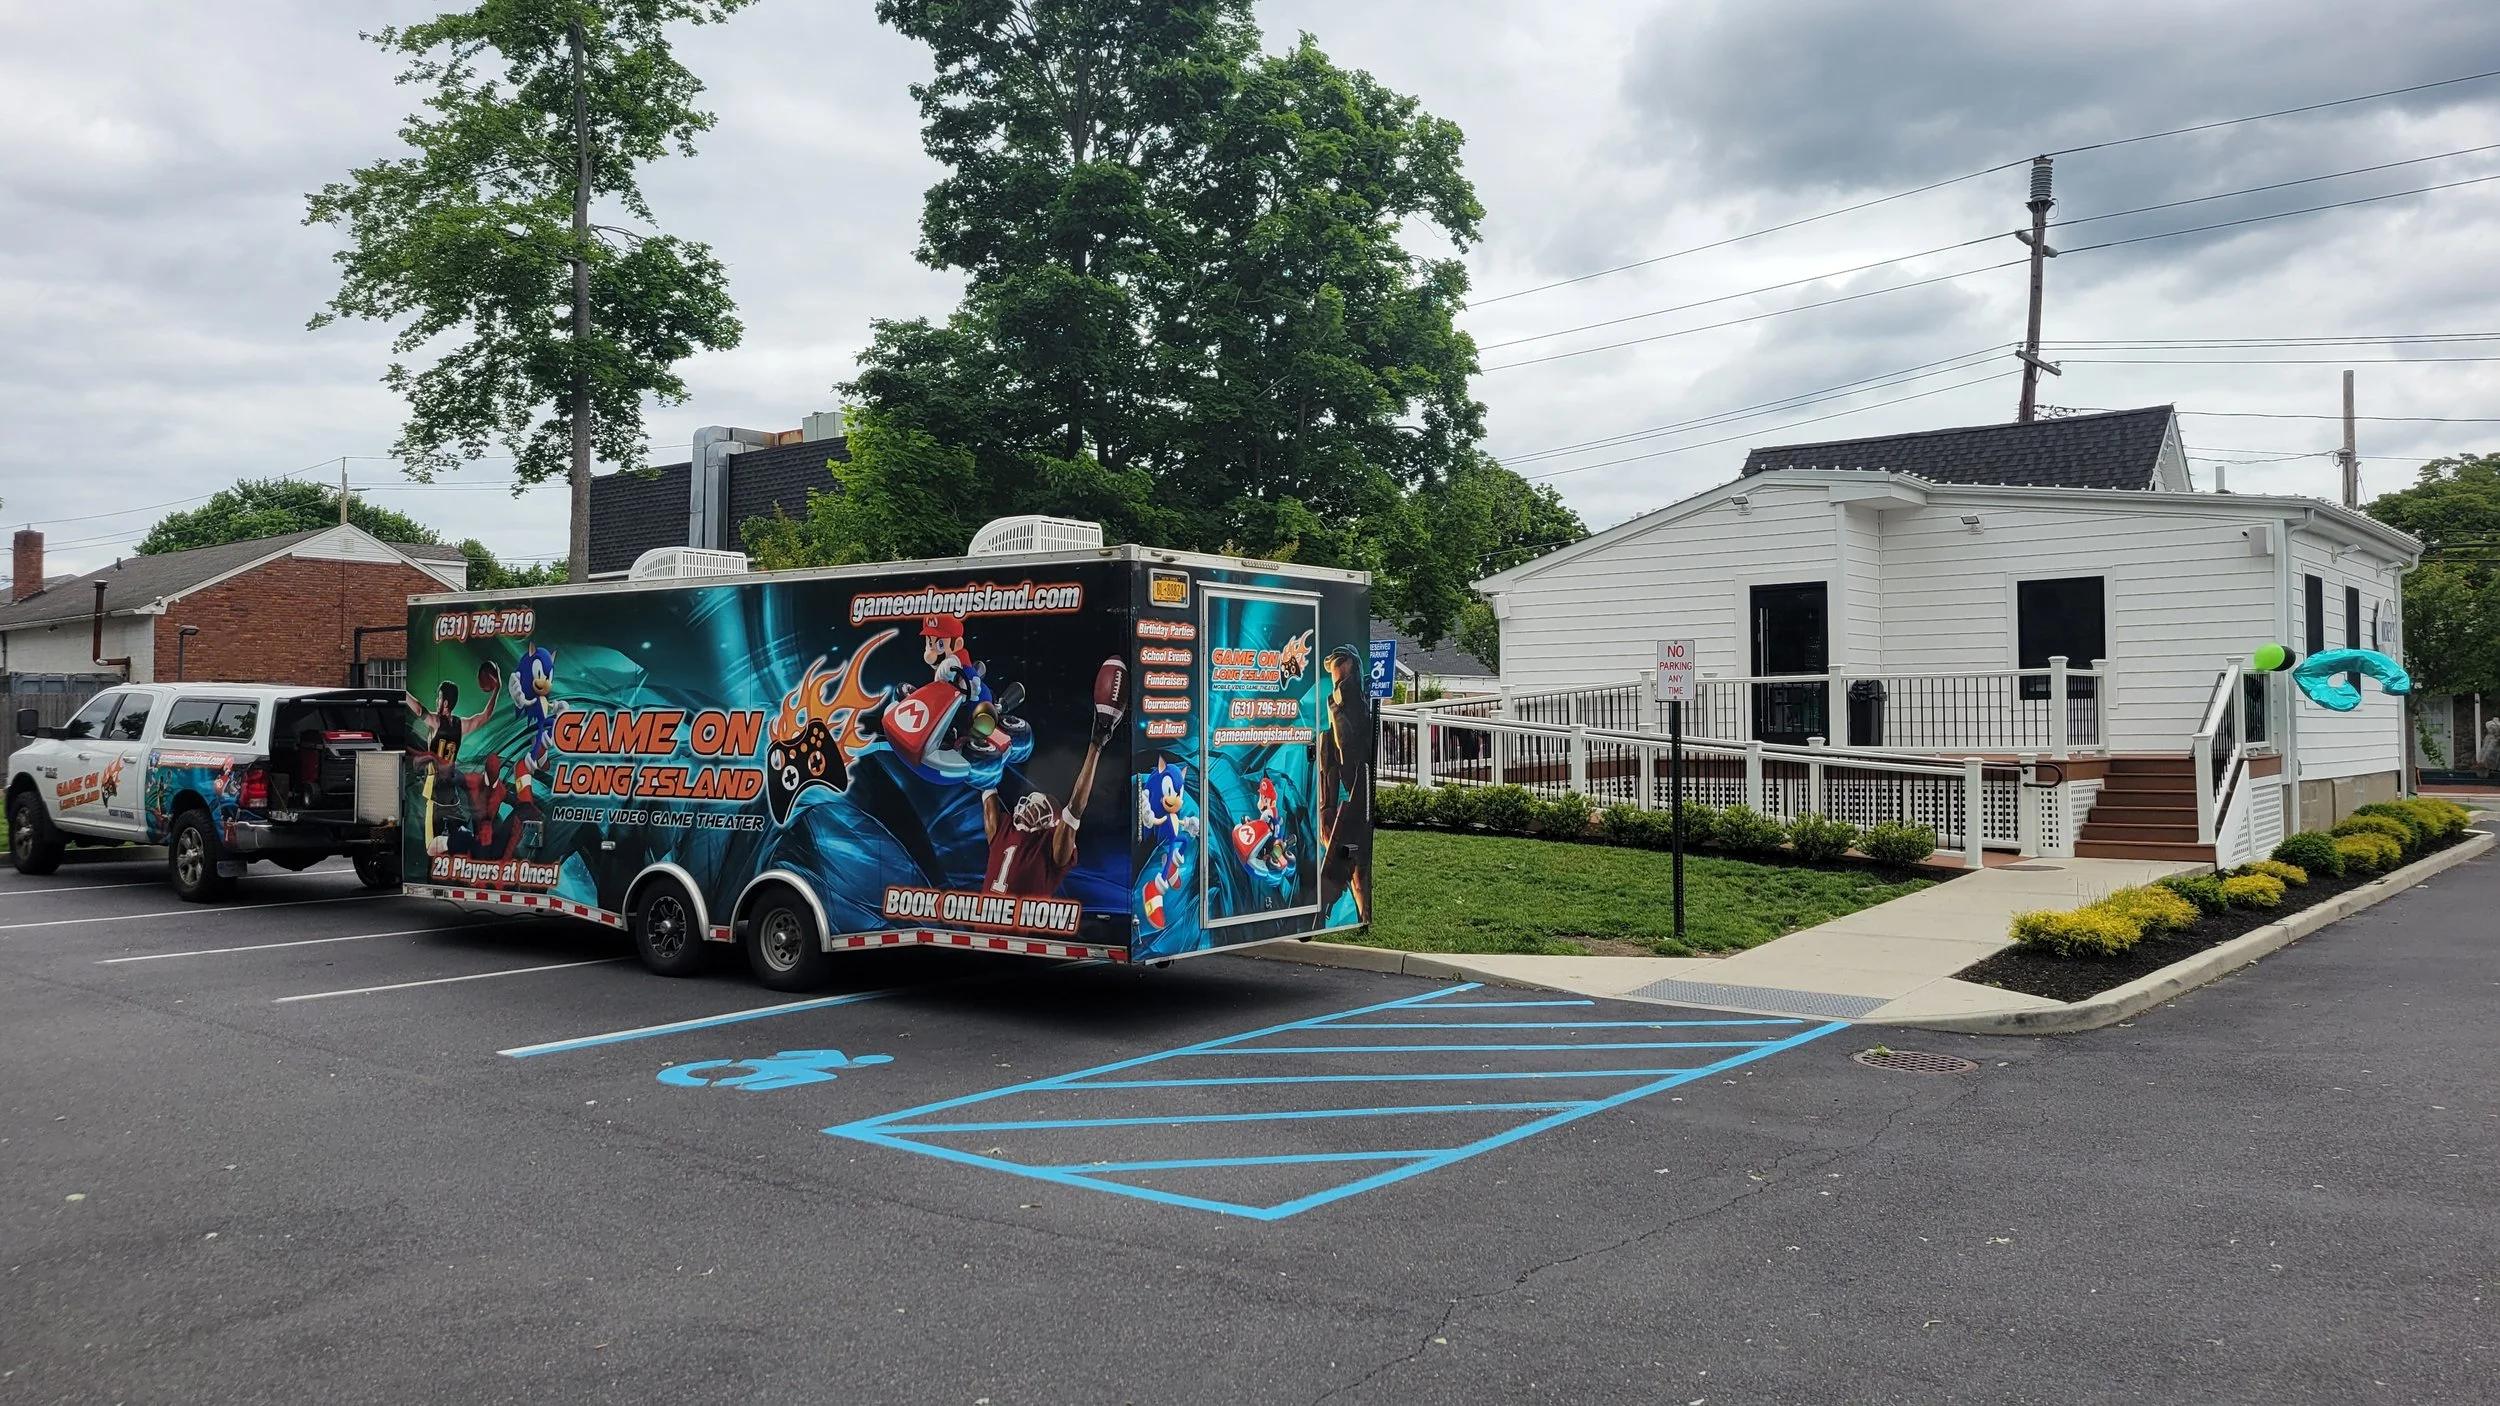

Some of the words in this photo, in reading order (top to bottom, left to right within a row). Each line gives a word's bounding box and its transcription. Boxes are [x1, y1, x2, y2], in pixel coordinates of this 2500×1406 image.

[852, 584, 1081, 622] gameonlongisland.com
[435, 615, 468, 641] (631)
[471, 612, 534, 635] 796-7019
[1138, 622, 1168, 637] Birthday
[1170, 625, 1194, 637] Parties
[1142, 650, 1167, 661] School
[1167, 651, 1191, 662] Events
[1212, 649, 1255, 666] GAME
[1258, 651, 1280, 667] ON
[1667, 645, 1684, 658] NO
[1659, 661, 1693, 671] PARKING
[1146, 674, 1188, 686] Fundraisers
[1213, 669, 1241, 680] LONG
[1241, 670, 1280, 681] ISLAND
[1667, 674, 1684, 683] ANY
[1371, 681, 1390, 689] PERMIT
[1667, 686, 1684, 695] TIME
[1144, 699, 1189, 710] Tournaments
[1231, 702, 1255, 719] (631)
[1257, 702, 1298, 716] 796-7019
[554, 711, 685, 755] GAME
[690, 711, 764, 757] ON
[1148, 724, 1163, 735] And
[1164, 724, 1185, 735] More!
[1214, 727, 1312, 745] gameonlongisland.com
[56, 776, 83, 797] GAME
[84, 771, 99, 789] ON
[553, 764, 635, 796] LONG
[635, 766, 764, 800] ISLAND
[552, 806, 604, 822] MOBILE
[607, 808, 648, 825] VIDEO
[651, 811, 693, 827] GAME
[697, 813, 764, 831] THEATER
[432, 856, 451, 877] 28
[451, 856, 499, 883] Players
[502, 861, 518, 882] at
[519, 860, 560, 885] Once!
[990, 844, 1018, 894] 1
[885, 888, 940, 918] BOOK
[942, 894, 1016, 925] ONLINE
[1018, 899, 1079, 931] NOW!
